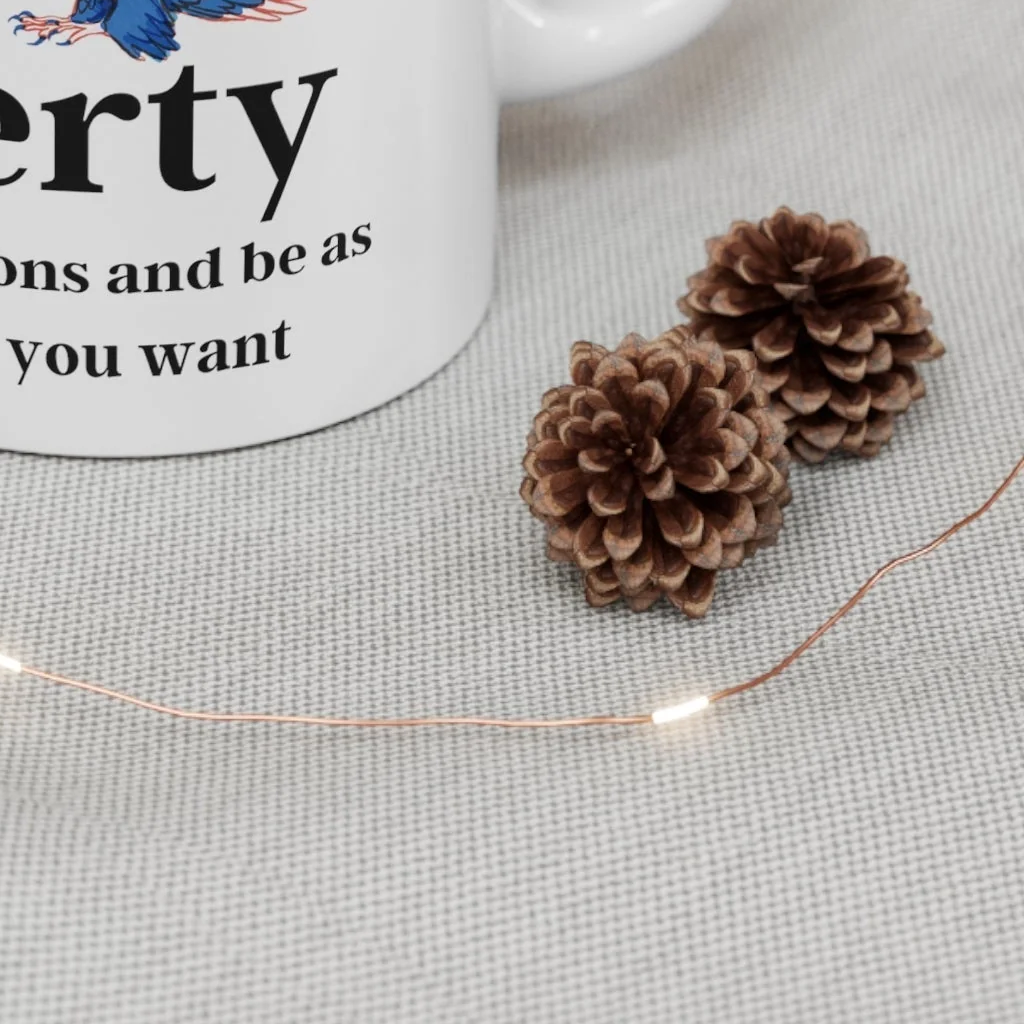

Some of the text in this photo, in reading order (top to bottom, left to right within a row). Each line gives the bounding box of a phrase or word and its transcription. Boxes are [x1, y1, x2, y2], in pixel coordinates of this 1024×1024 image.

[107, 246, 224, 294] and
[241, 241, 307, 284] be
[322, 222, 373, 266] as
[5, 338, 122, 386] you
[138, 319, 292, 377] want
